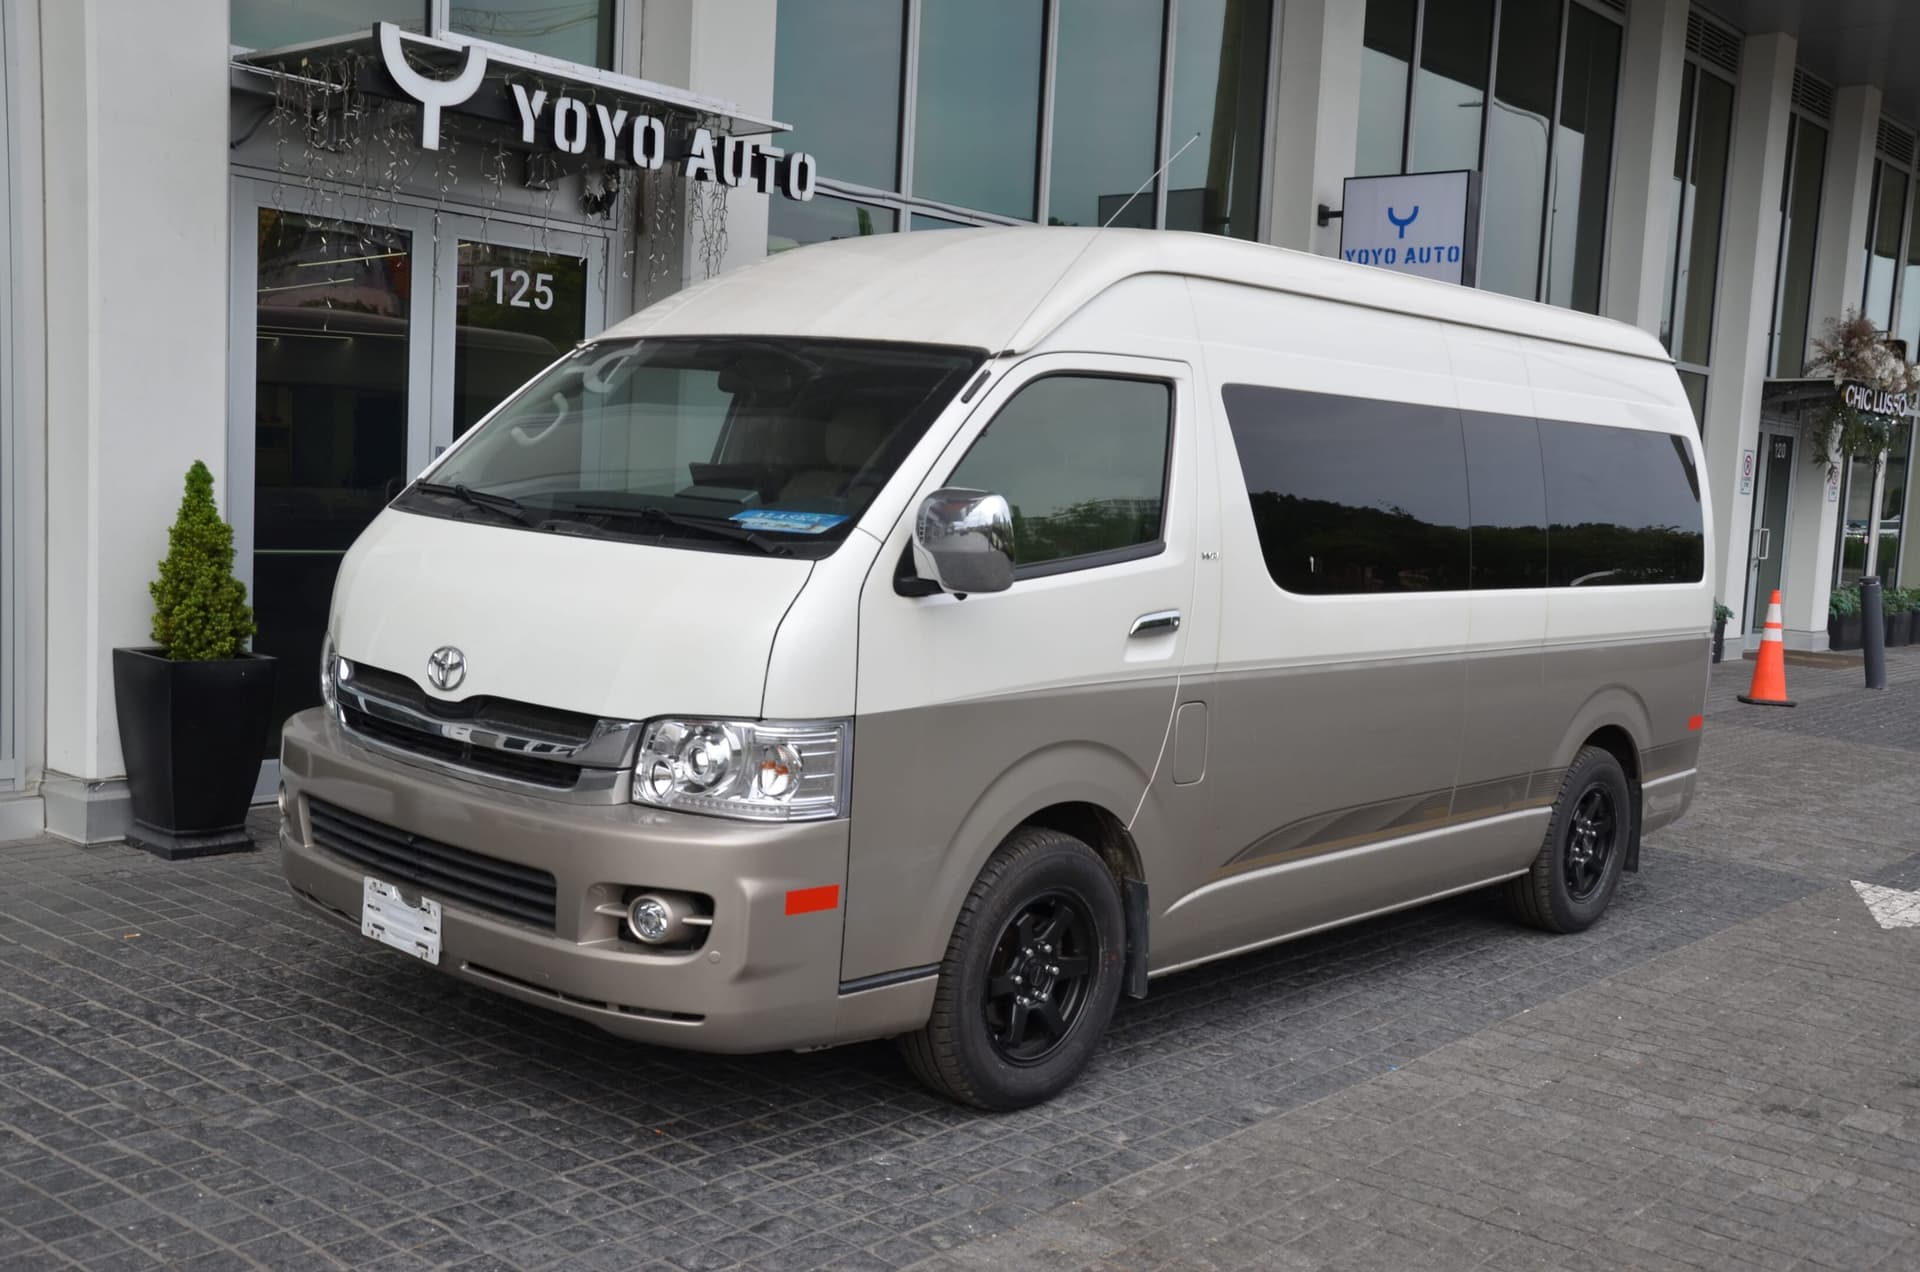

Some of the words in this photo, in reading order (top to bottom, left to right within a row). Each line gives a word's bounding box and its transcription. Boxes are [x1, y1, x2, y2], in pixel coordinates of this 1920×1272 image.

[511, 83, 666, 170] YOYO
[685, 127, 817, 202] AUTO
[1345, 247, 1396, 266] YOYO
[1404, 245, 1460, 264] AUTO
[490, 267, 554, 311] 125
[1845, 384, 1873, 411] CHIC
[1774, 442, 1786, 458] 120
